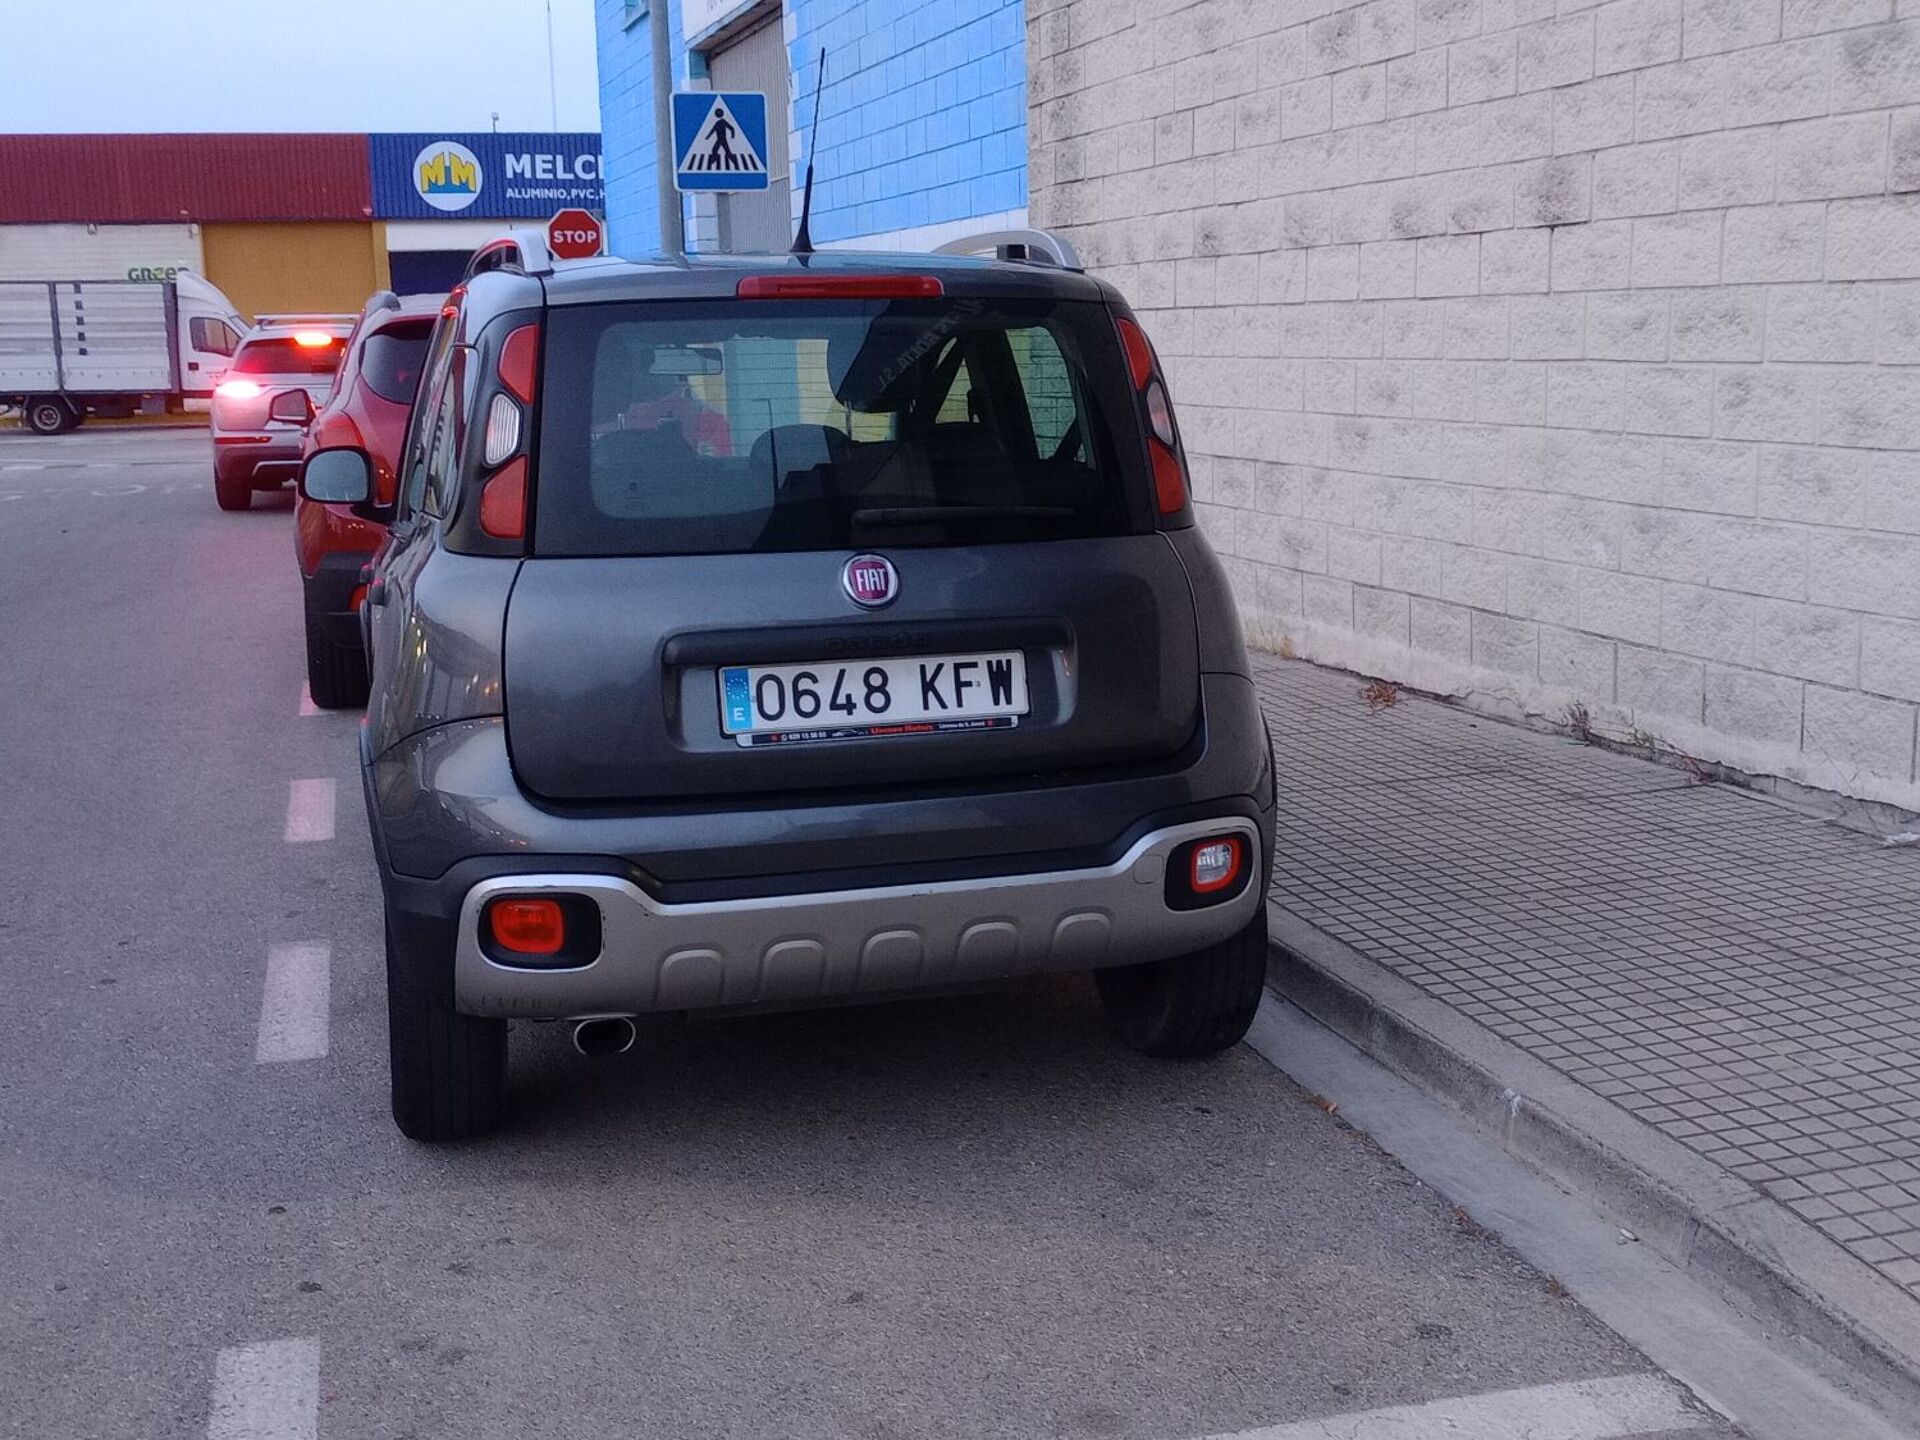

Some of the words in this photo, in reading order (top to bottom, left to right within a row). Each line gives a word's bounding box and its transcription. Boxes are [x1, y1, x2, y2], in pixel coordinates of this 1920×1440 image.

[553, 230, 598, 244] STOP
[855, 568, 886, 591] FIAT
[755, 666, 892, 721] 0648
[919, 658, 1013, 711] KFW
[733, 707, 746, 721] E
